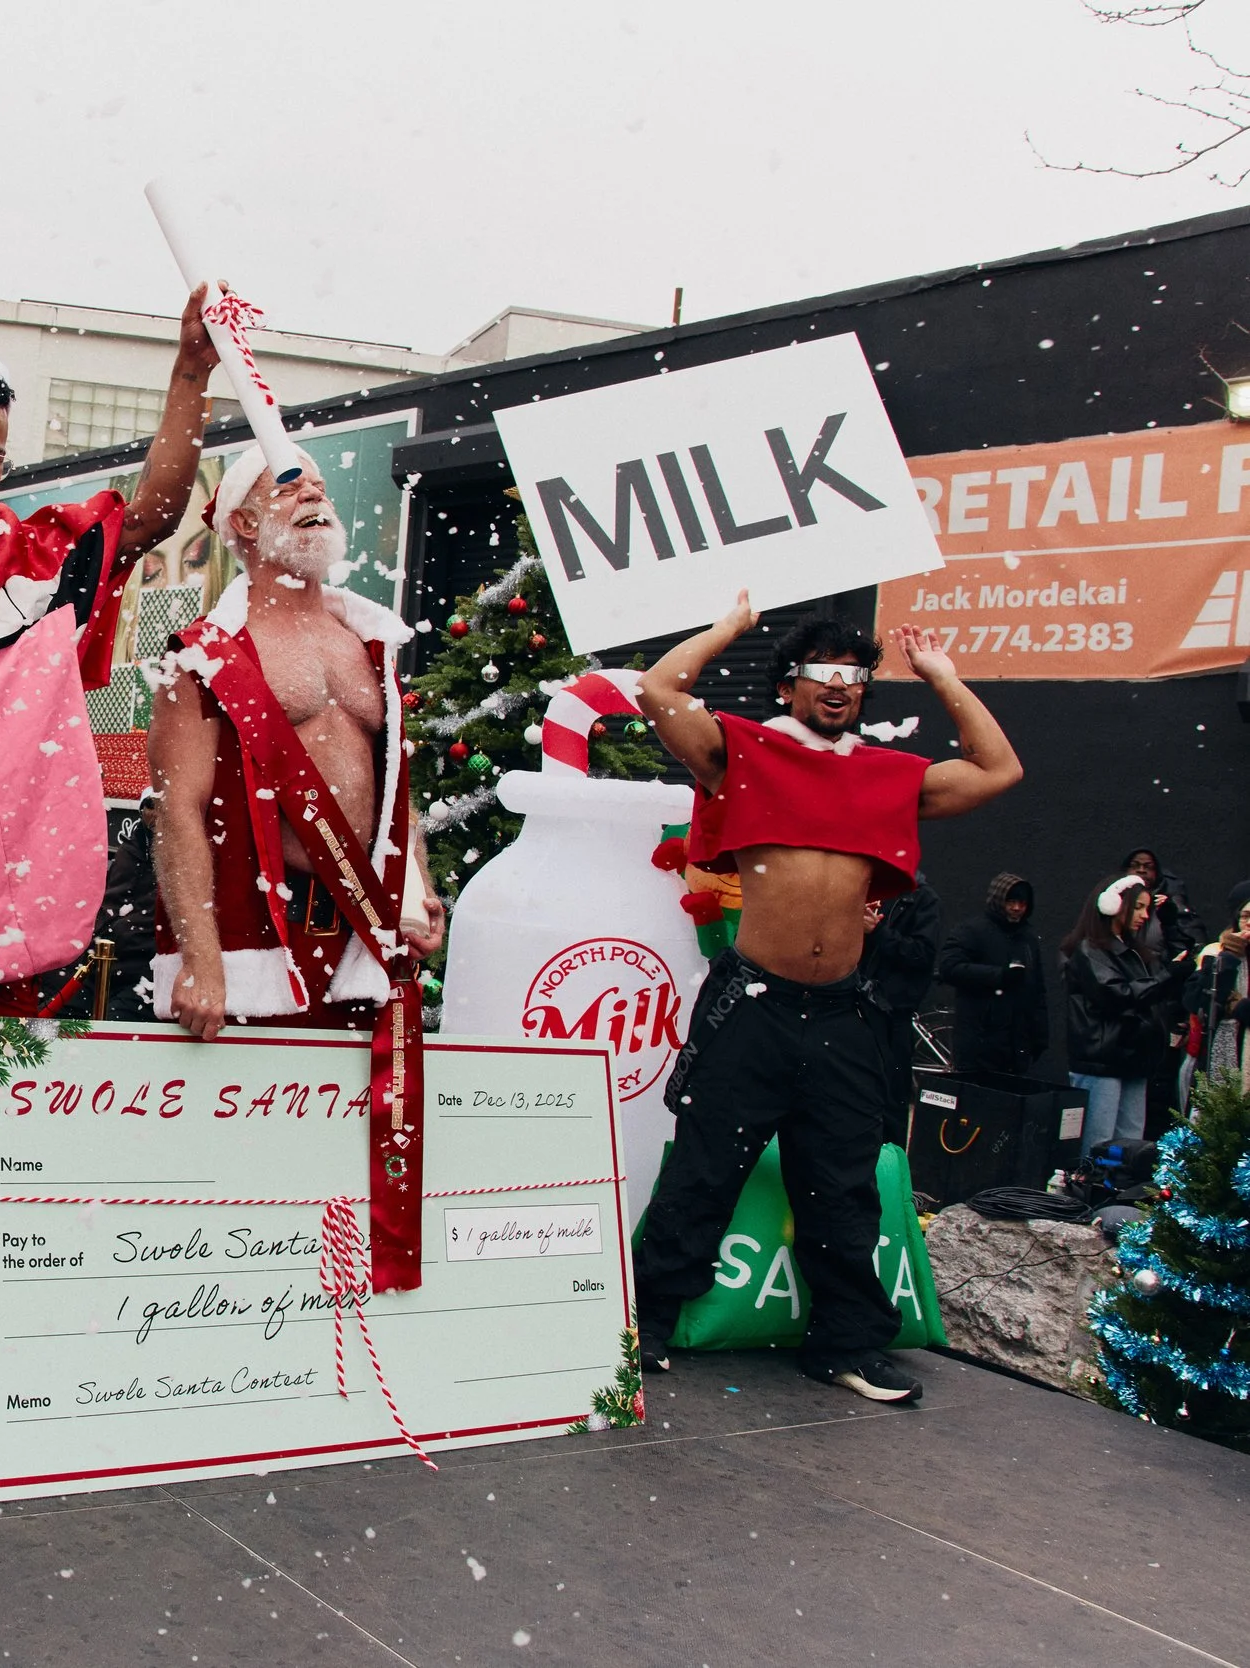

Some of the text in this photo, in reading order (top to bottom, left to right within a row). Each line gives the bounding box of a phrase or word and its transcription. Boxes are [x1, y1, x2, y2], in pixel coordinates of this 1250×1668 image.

[536, 412, 887, 582] MILK
[912, 453, 1188, 535] RETAIL
[910, 578, 1127, 612] Jack Mordekai
[315, 818, 382, 927] SWOLE SANTA 2025
[538, 946, 606, 999] NORTH
[521, 982, 685, 1057] Milk
[391, 1003, 405, 1130] SWOLE SANTA 2025
[5, 1079, 371, 1119] SWOLE SANTA
[438, 1090, 576, 1110] Date Dec 13, 2025
[0, 1157, 43, 1172] Name
[2, 1233, 46, 1251] Pay to
[113, 1228, 213, 1263] Swole
[224, 1228, 322, 1260] Santa
[452, 1227, 458, 1242] $
[477, 1222, 533, 1255] gallon
[537, 1222, 554, 1254] of
[557, 1218, 593, 1238] milk
[2, 1252, 84, 1268] the order of
[573, 1279, 605, 1292] Dollars
[117, 1296, 129, 1320] 1
[136, 1284, 253, 1344] gallon
[260, 1284, 294, 1339] of
[7, 1366, 319, 1409] Memo Swole Santa Contest
